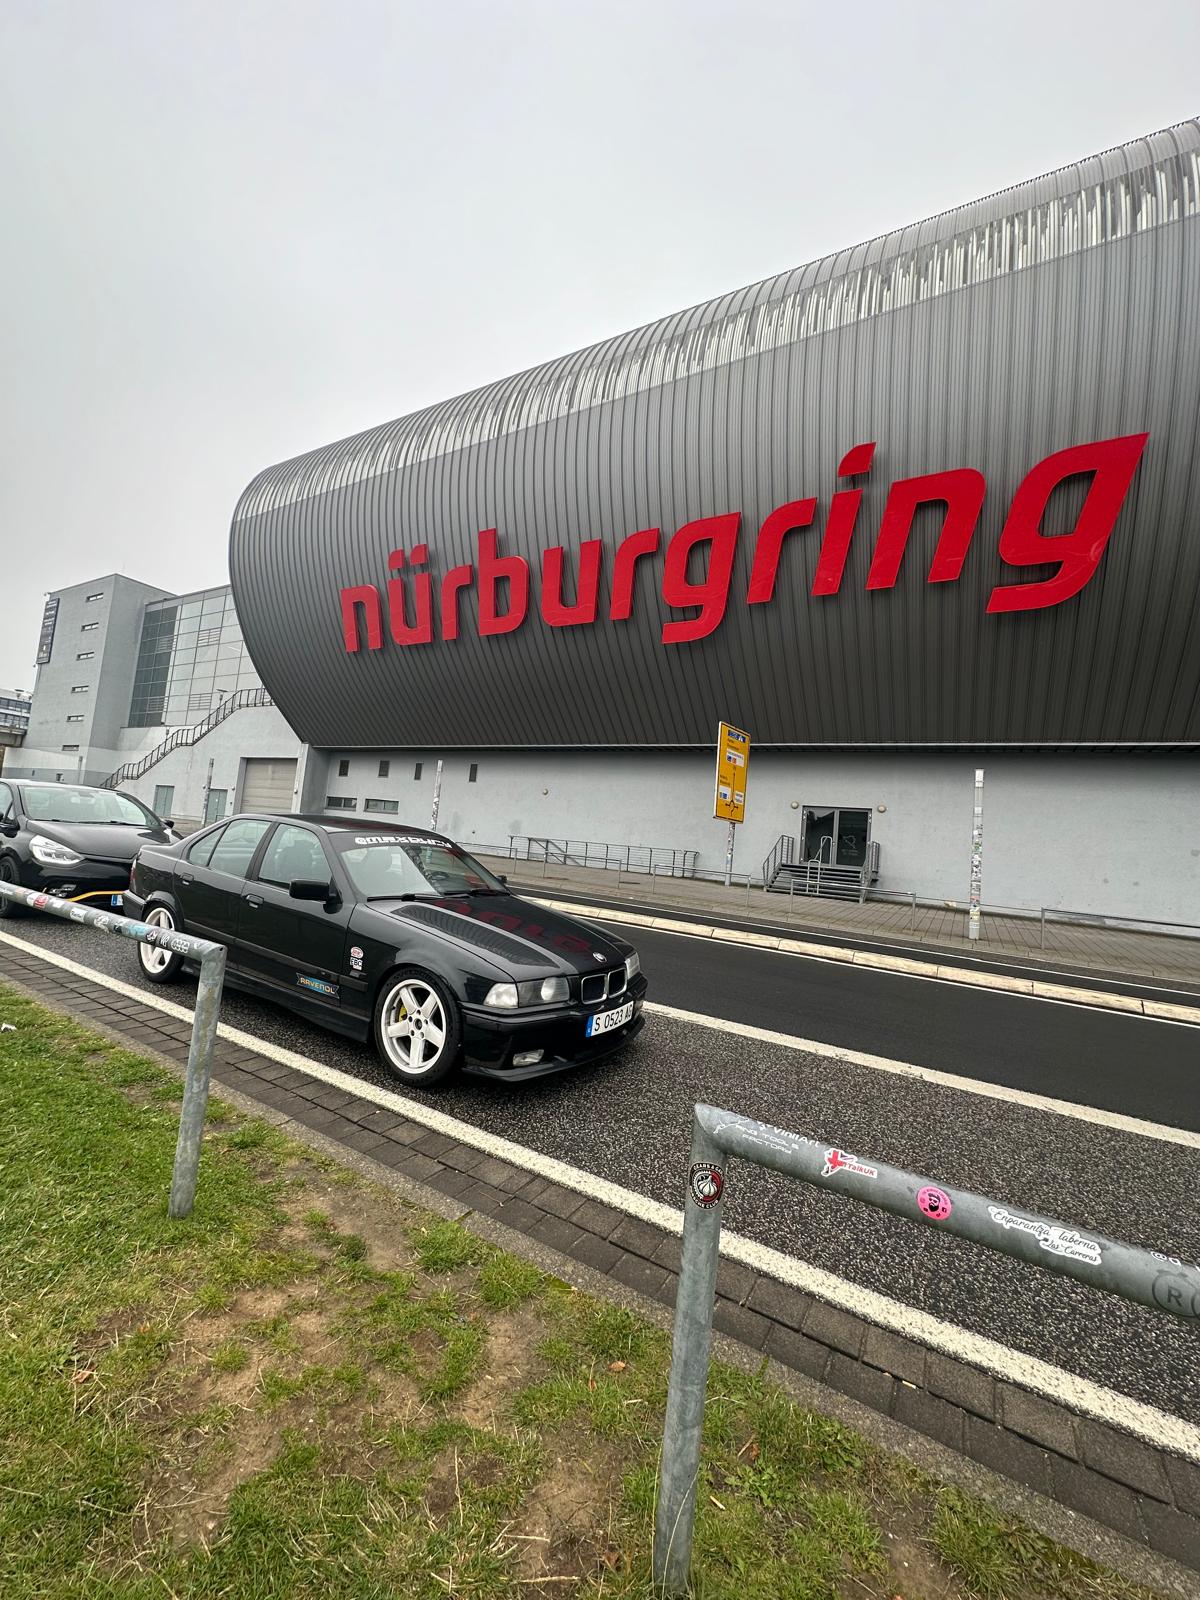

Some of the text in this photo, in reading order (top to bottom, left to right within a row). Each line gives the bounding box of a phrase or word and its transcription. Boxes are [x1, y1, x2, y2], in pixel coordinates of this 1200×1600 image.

[341, 432, 1149, 654] nürburgring
[300, 977, 336, 994] RAVENOL
[594, 1017, 601, 1032] S
[604, 1009, 623, 1029] 0523
